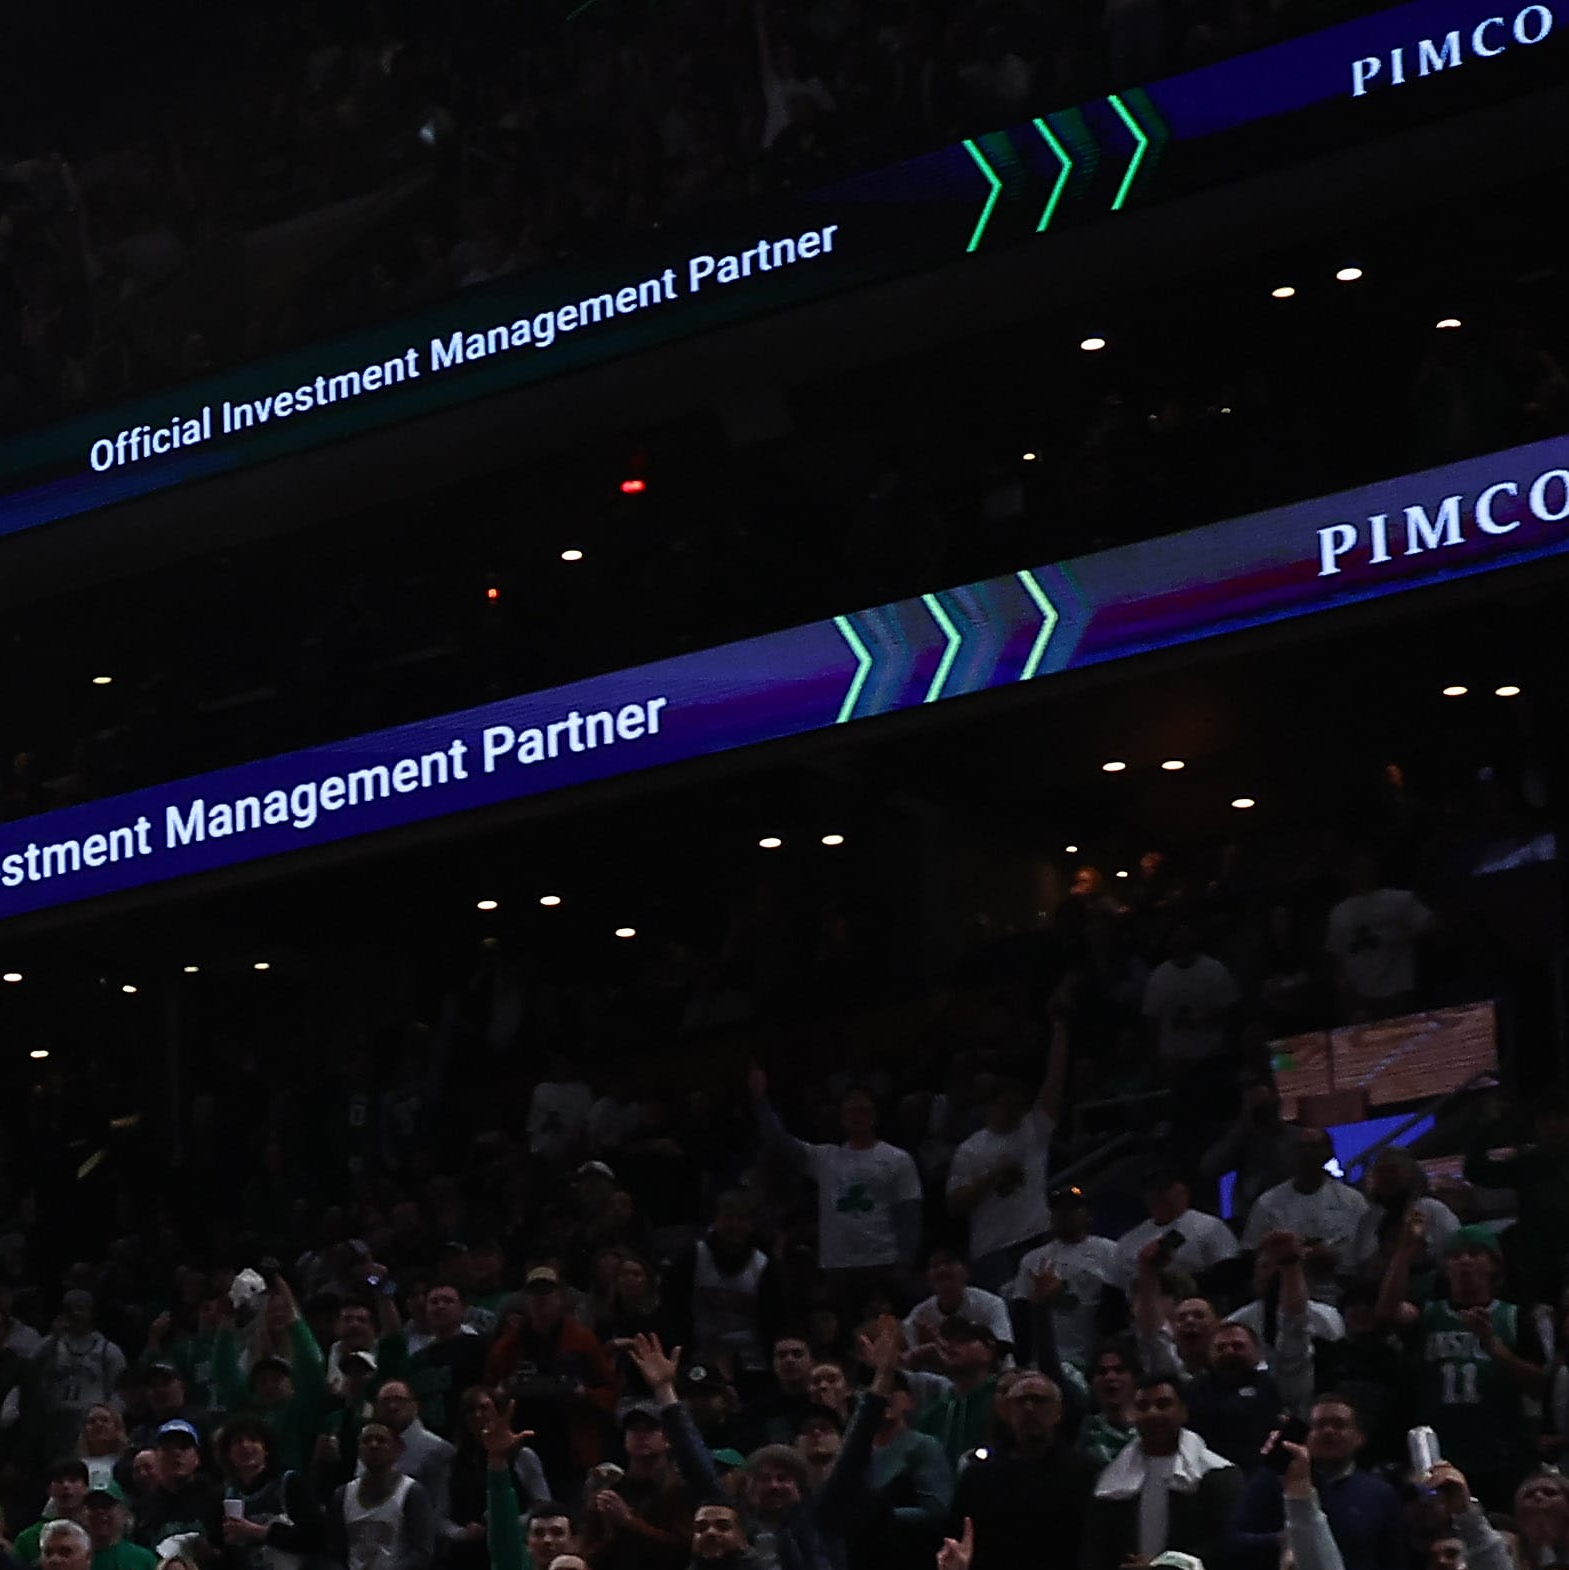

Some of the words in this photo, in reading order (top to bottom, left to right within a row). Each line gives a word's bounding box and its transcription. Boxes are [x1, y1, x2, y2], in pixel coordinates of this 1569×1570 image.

[1352, 5, 1553, 97] PIMCO
[90, 406, 211, 472] Official
[223, 348, 420, 434] Investment
[431, 268, 678, 371] Management
[689, 225, 838, 292] Partner
[1316, 469, 1569, 576] PIMCO
[166, 739, 469, 849] Management
[483, 697, 667, 773] Partner
